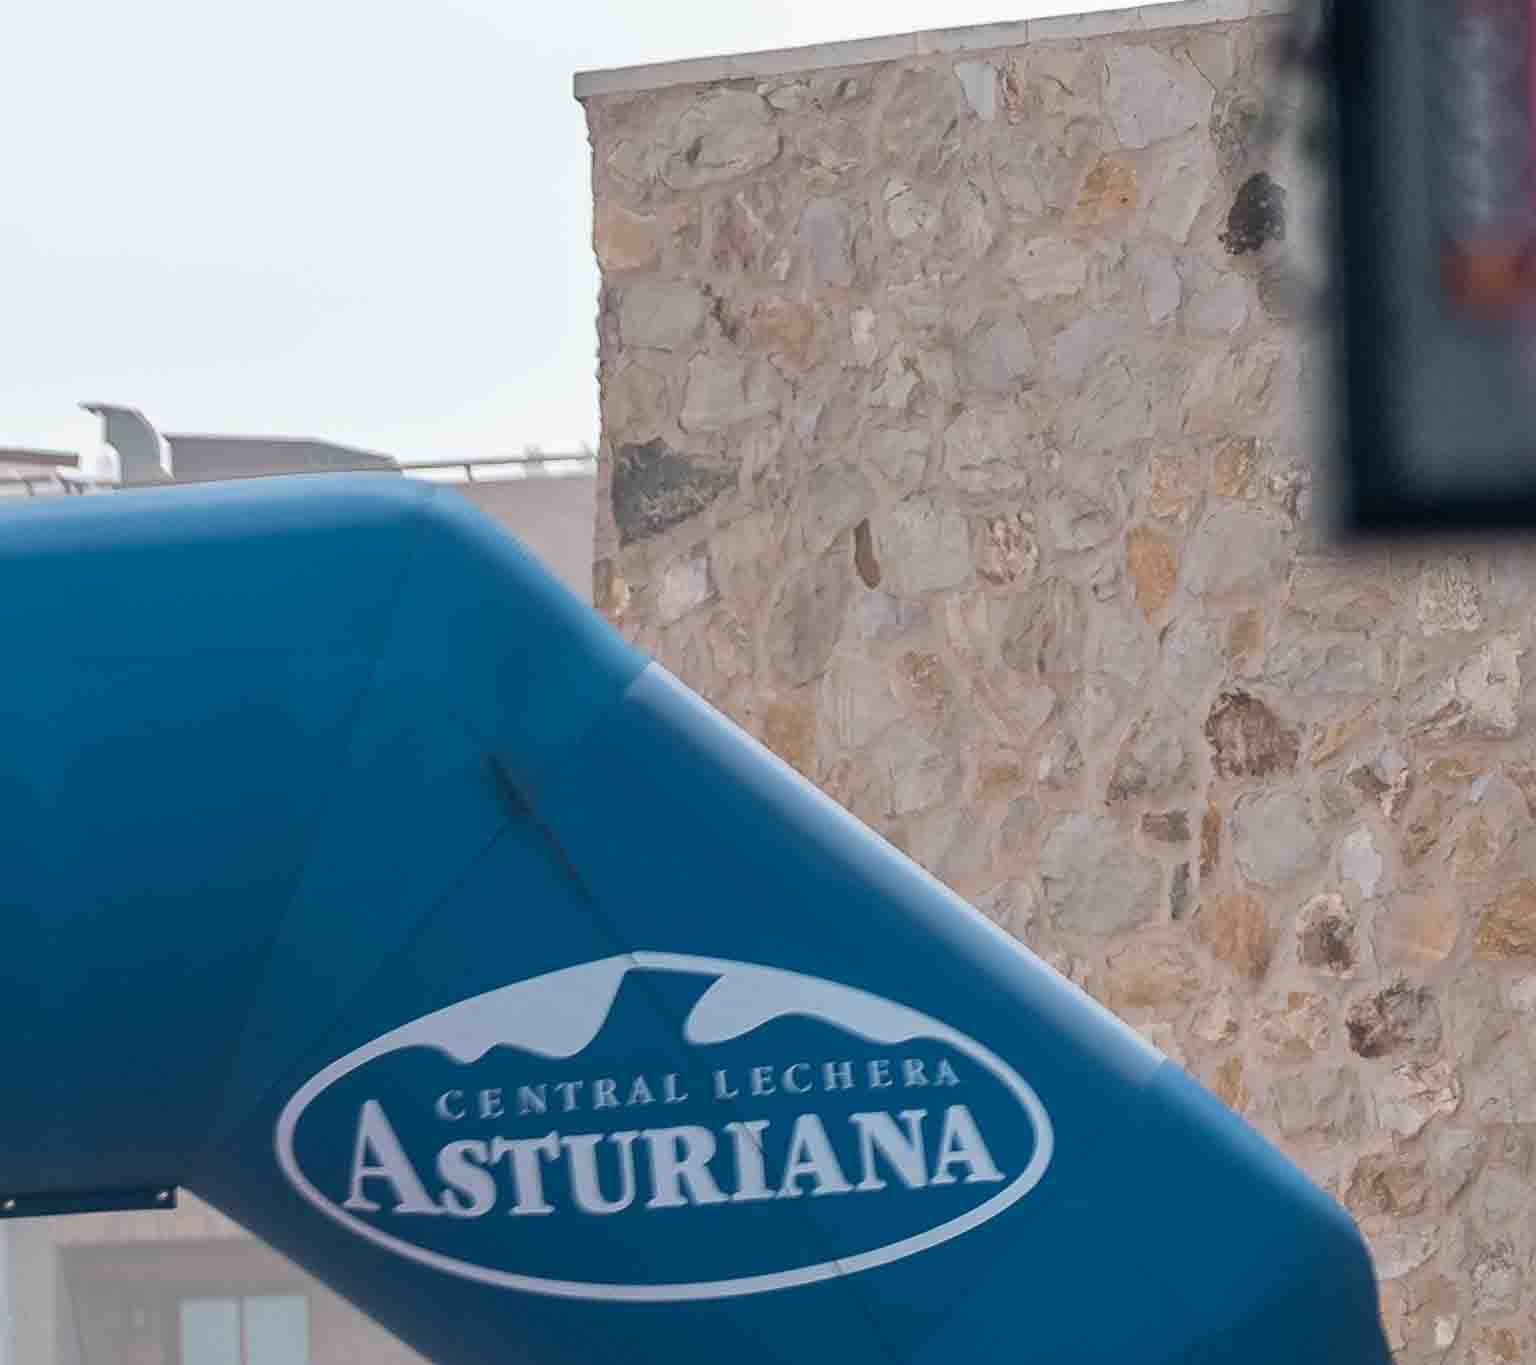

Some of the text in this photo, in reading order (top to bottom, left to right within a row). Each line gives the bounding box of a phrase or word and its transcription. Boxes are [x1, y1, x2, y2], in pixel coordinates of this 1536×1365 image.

[436, 1056, 961, 1122] CENTRAL LECHERA
[345, 1098, 1006, 1218] ASTURIANA
